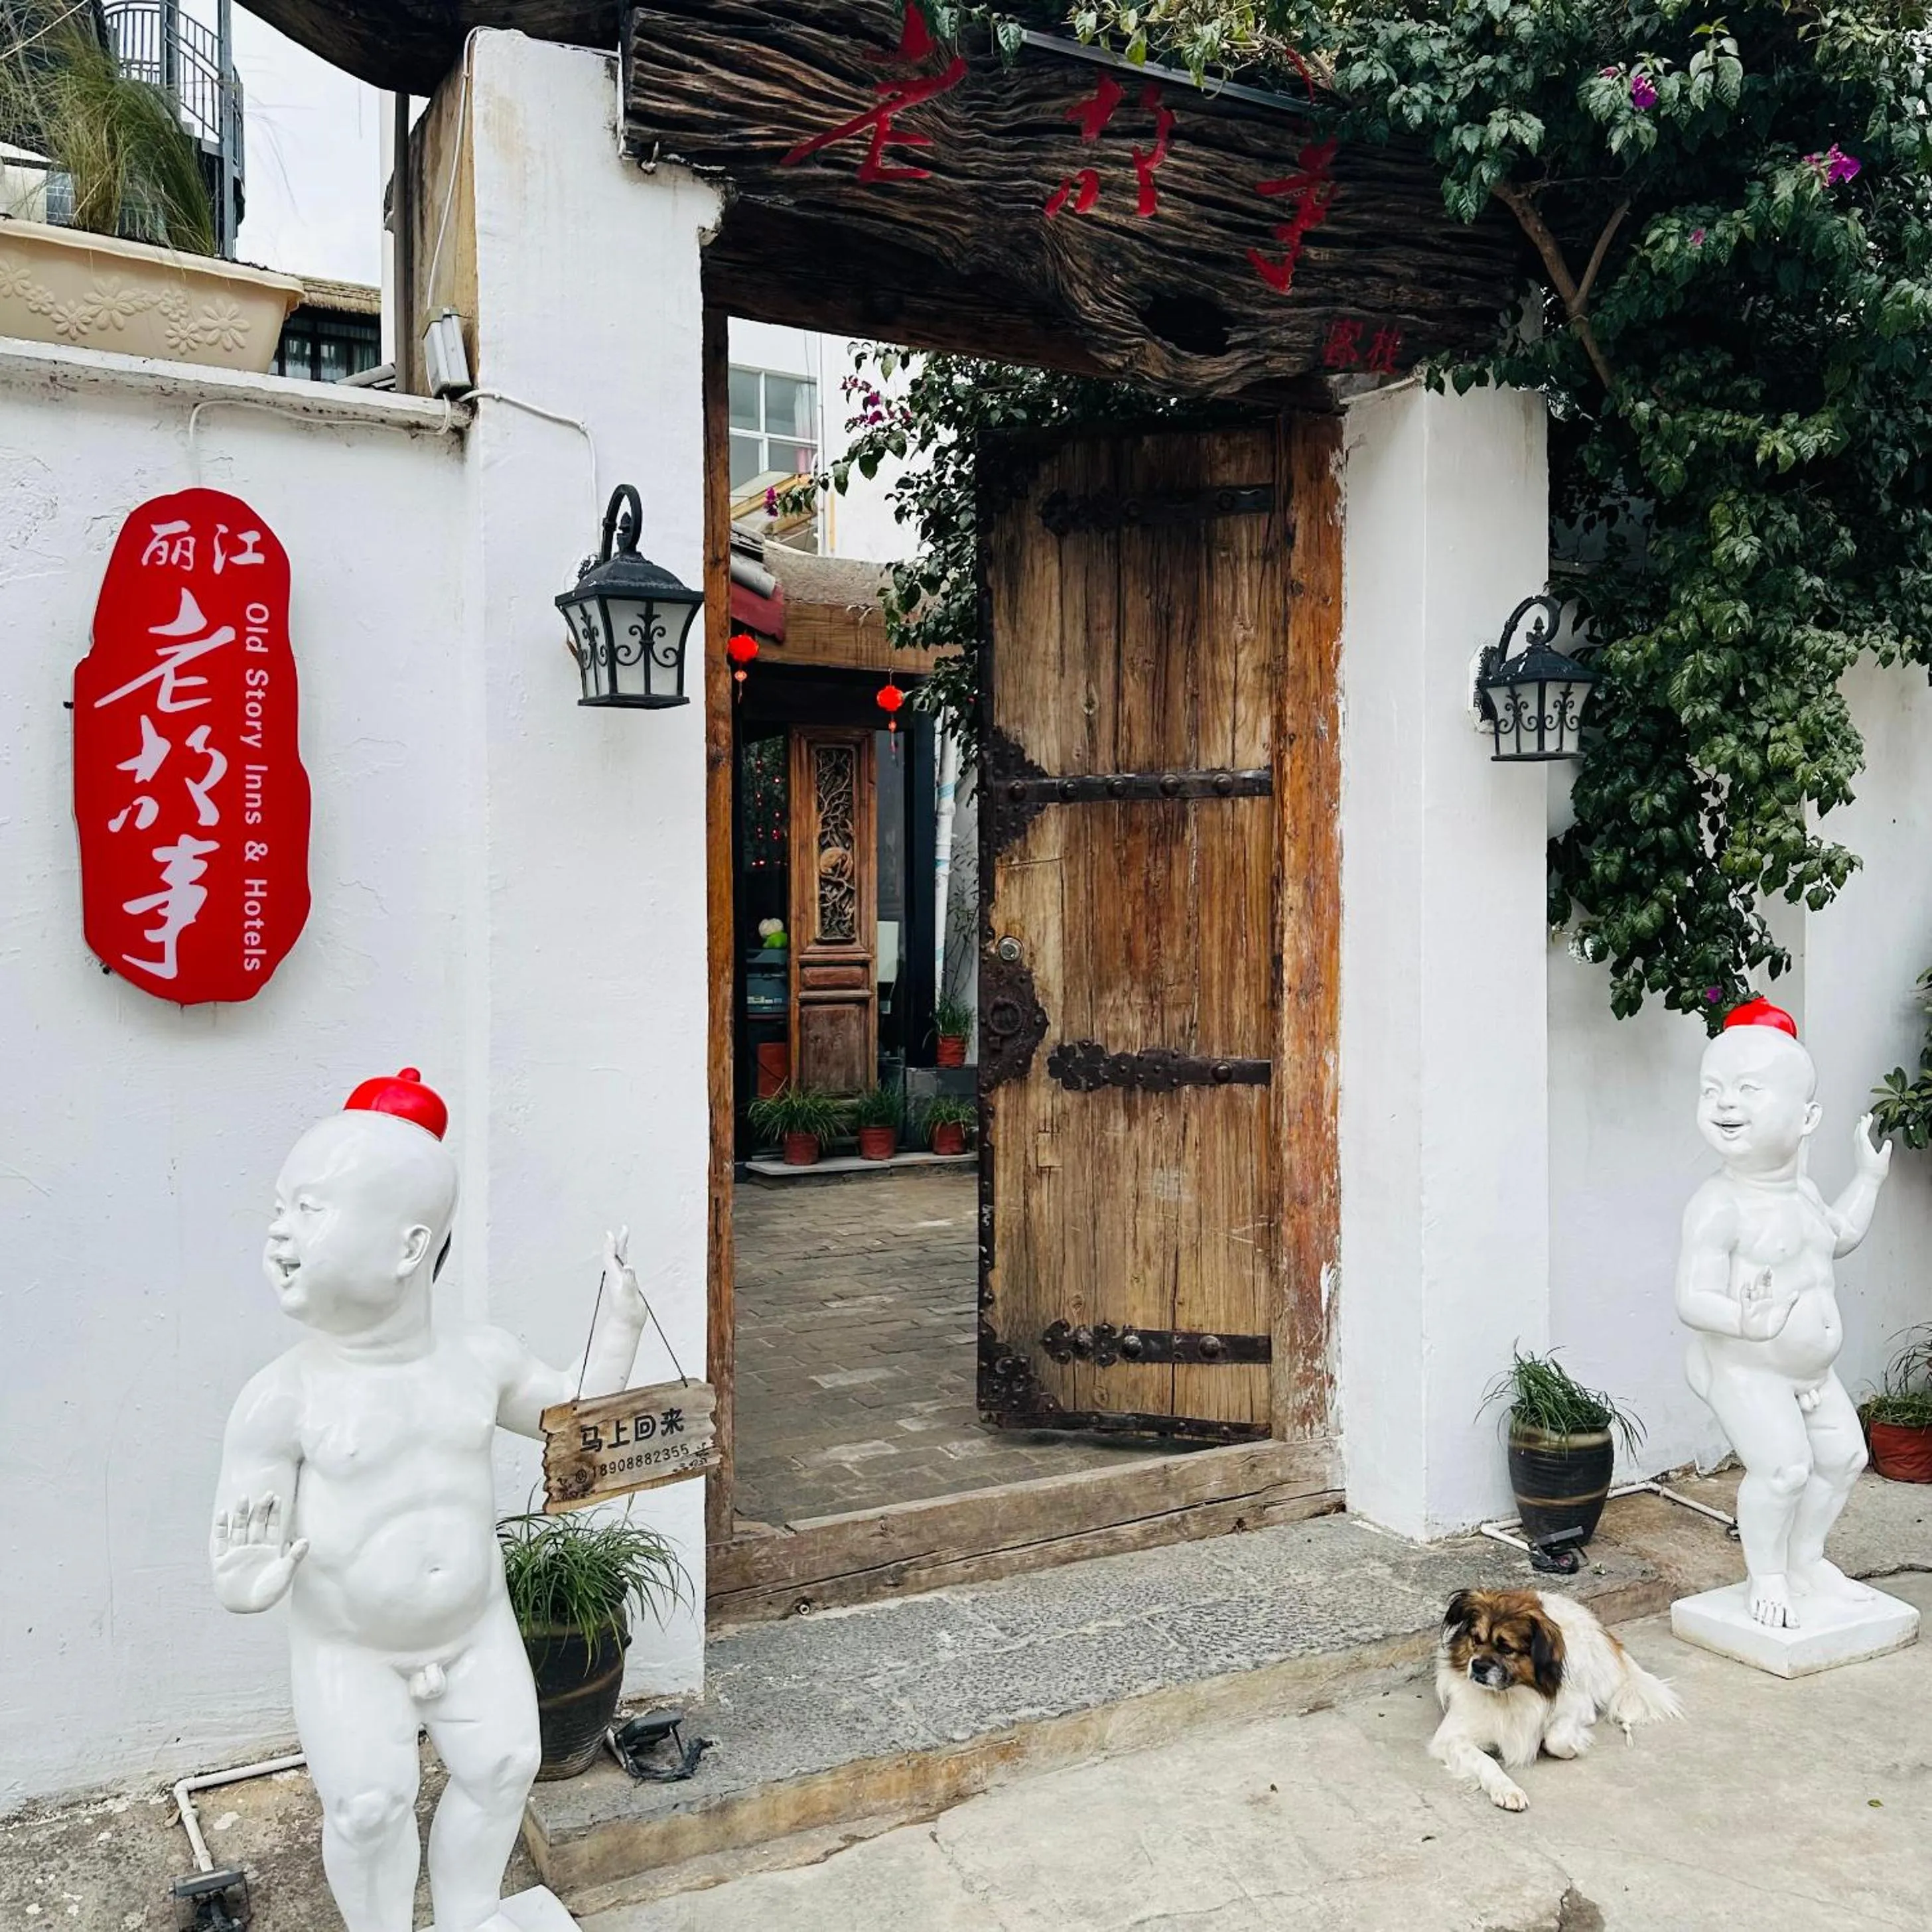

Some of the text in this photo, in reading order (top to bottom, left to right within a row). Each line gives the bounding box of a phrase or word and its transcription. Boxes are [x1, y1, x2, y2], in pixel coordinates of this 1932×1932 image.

[141, 519, 265, 575] 丽江
[94, 586, 238, 980] 老故事
[240, 602, 269, 972] Old Story Inns & Hotels
[579, 1407, 685, 1452] 马上回来
[592, 1443, 689, 1478] 18908882355
